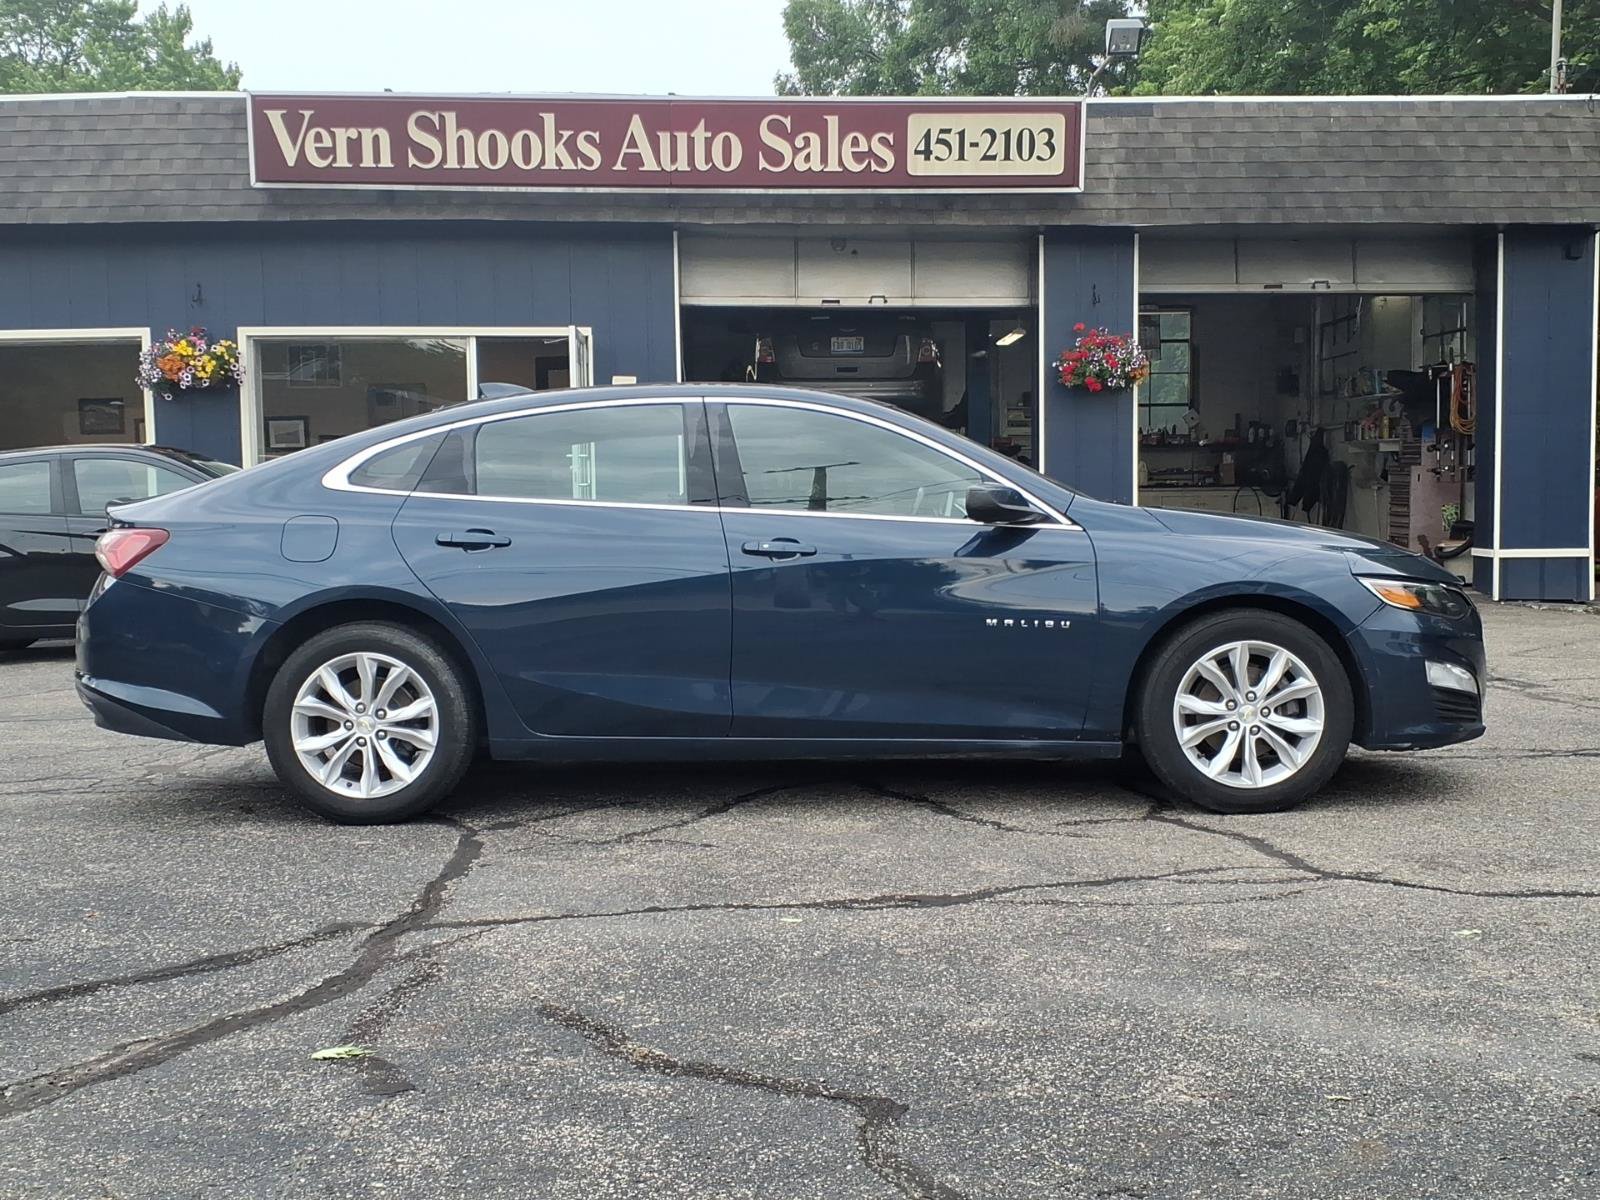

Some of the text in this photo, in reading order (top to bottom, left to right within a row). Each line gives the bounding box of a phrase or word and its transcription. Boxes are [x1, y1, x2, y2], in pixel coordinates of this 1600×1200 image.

[263, 109, 896, 174] Vern Shooks Auto Sales
[913, 127, 1057, 162] 451-2103
[985, 618, 1071, 629] MALIBU
